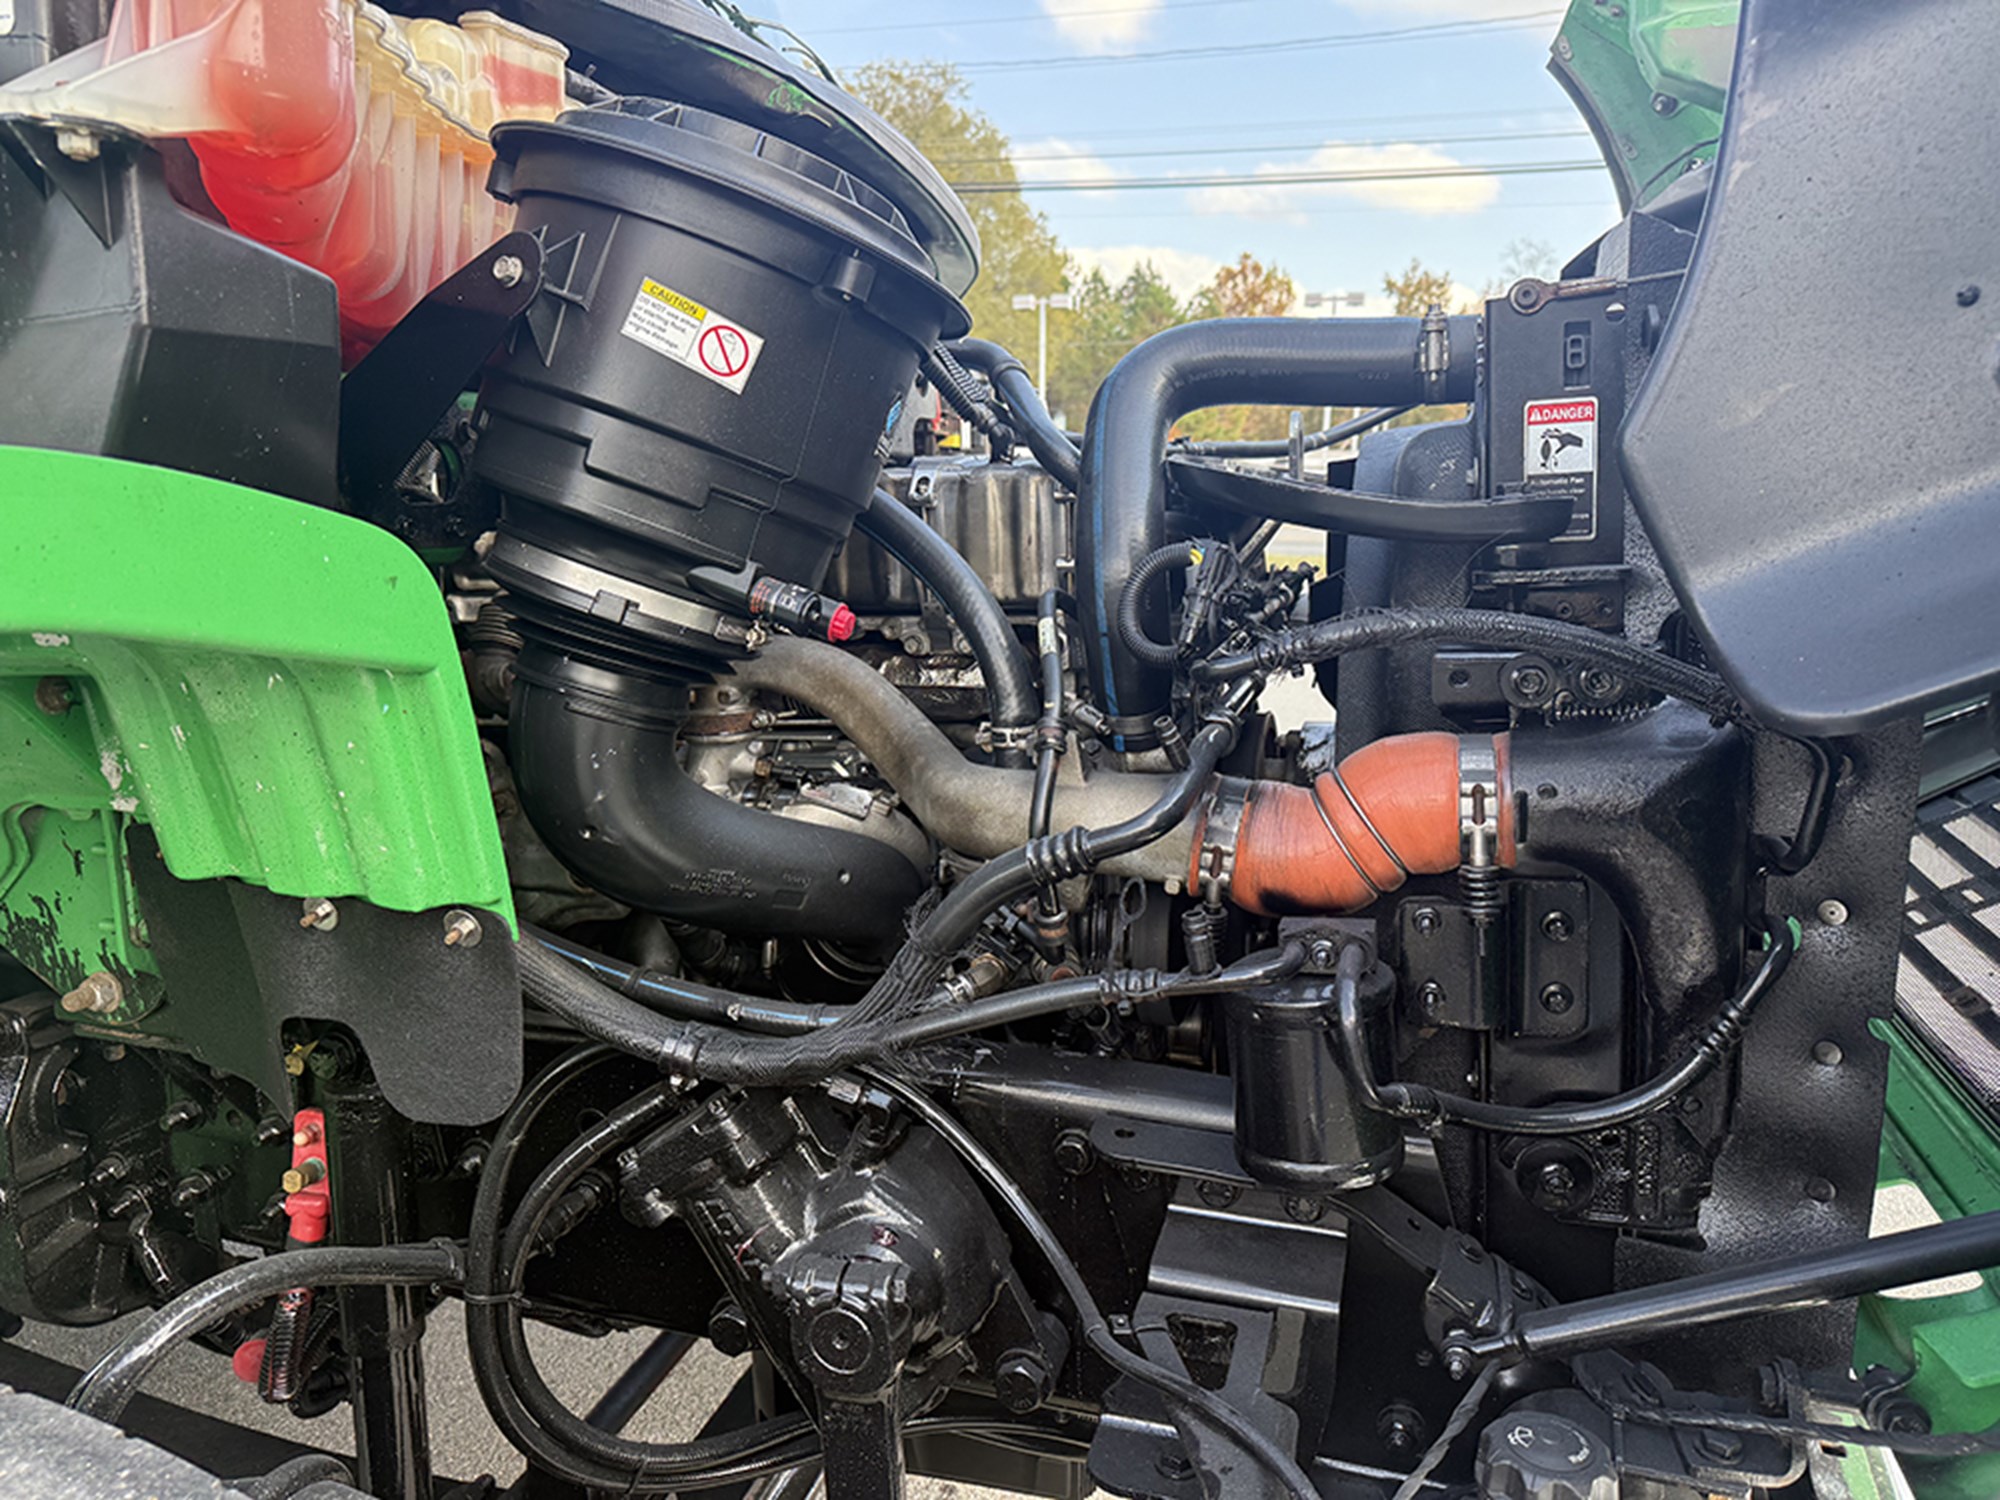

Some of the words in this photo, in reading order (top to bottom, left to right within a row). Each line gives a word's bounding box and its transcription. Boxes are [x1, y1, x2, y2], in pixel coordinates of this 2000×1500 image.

[649, 285, 699, 315] CAUTION
[651, 301, 667, 312] NOT
[1541, 406, 1594, 421] DANGER
